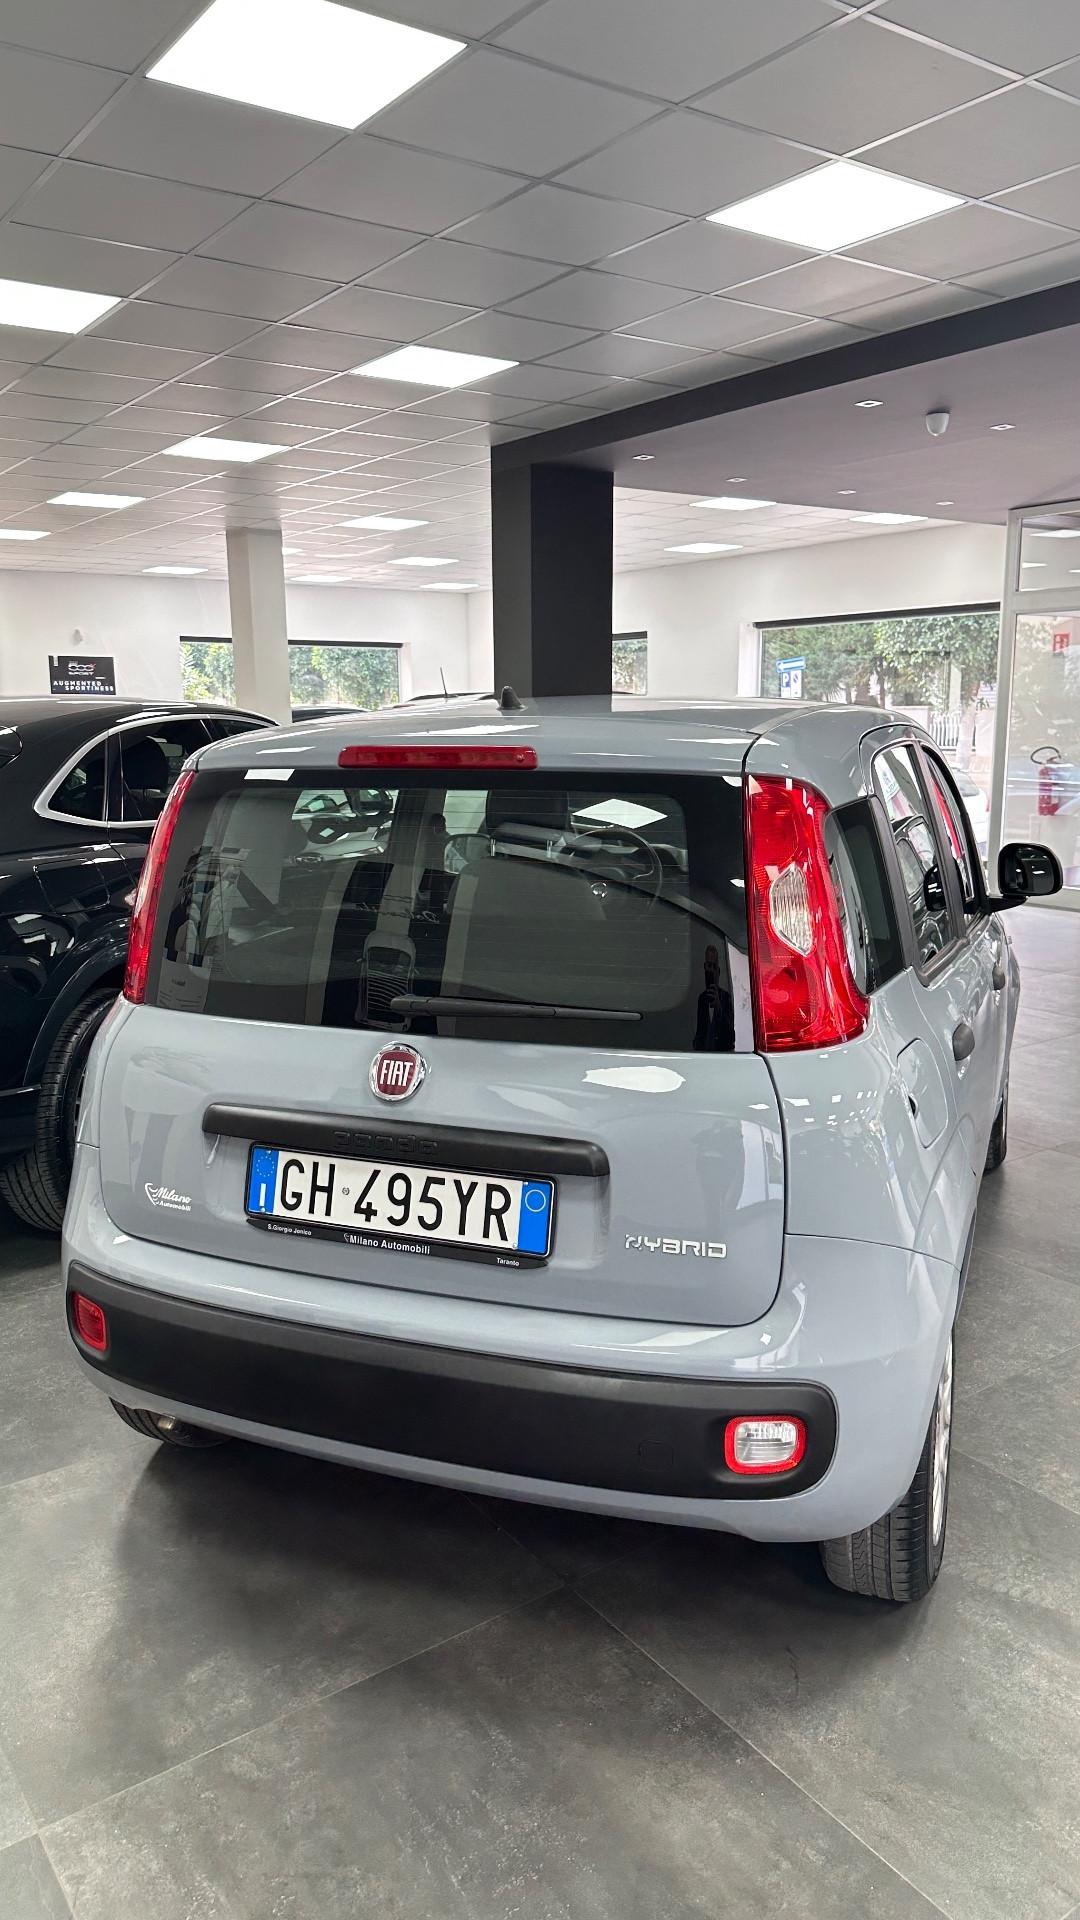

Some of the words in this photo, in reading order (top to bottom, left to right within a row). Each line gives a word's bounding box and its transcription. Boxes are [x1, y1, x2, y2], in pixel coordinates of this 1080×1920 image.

[782, 672, 790, 687] P
[380, 1060, 413, 1087] FIAT
[156, 1186, 193, 1204] Milano
[281, 1158, 336, 1216] GH
[354, 1169, 512, 1242] 495YR
[158, 1200, 192, 1212] Automobili
[349, 1234, 379, 1248] Milano
[381, 1239, 431, 1255] Automobili
[625, 1234, 727, 1258] HYBRID
[496, 1257, 520, 1267] Taranto
